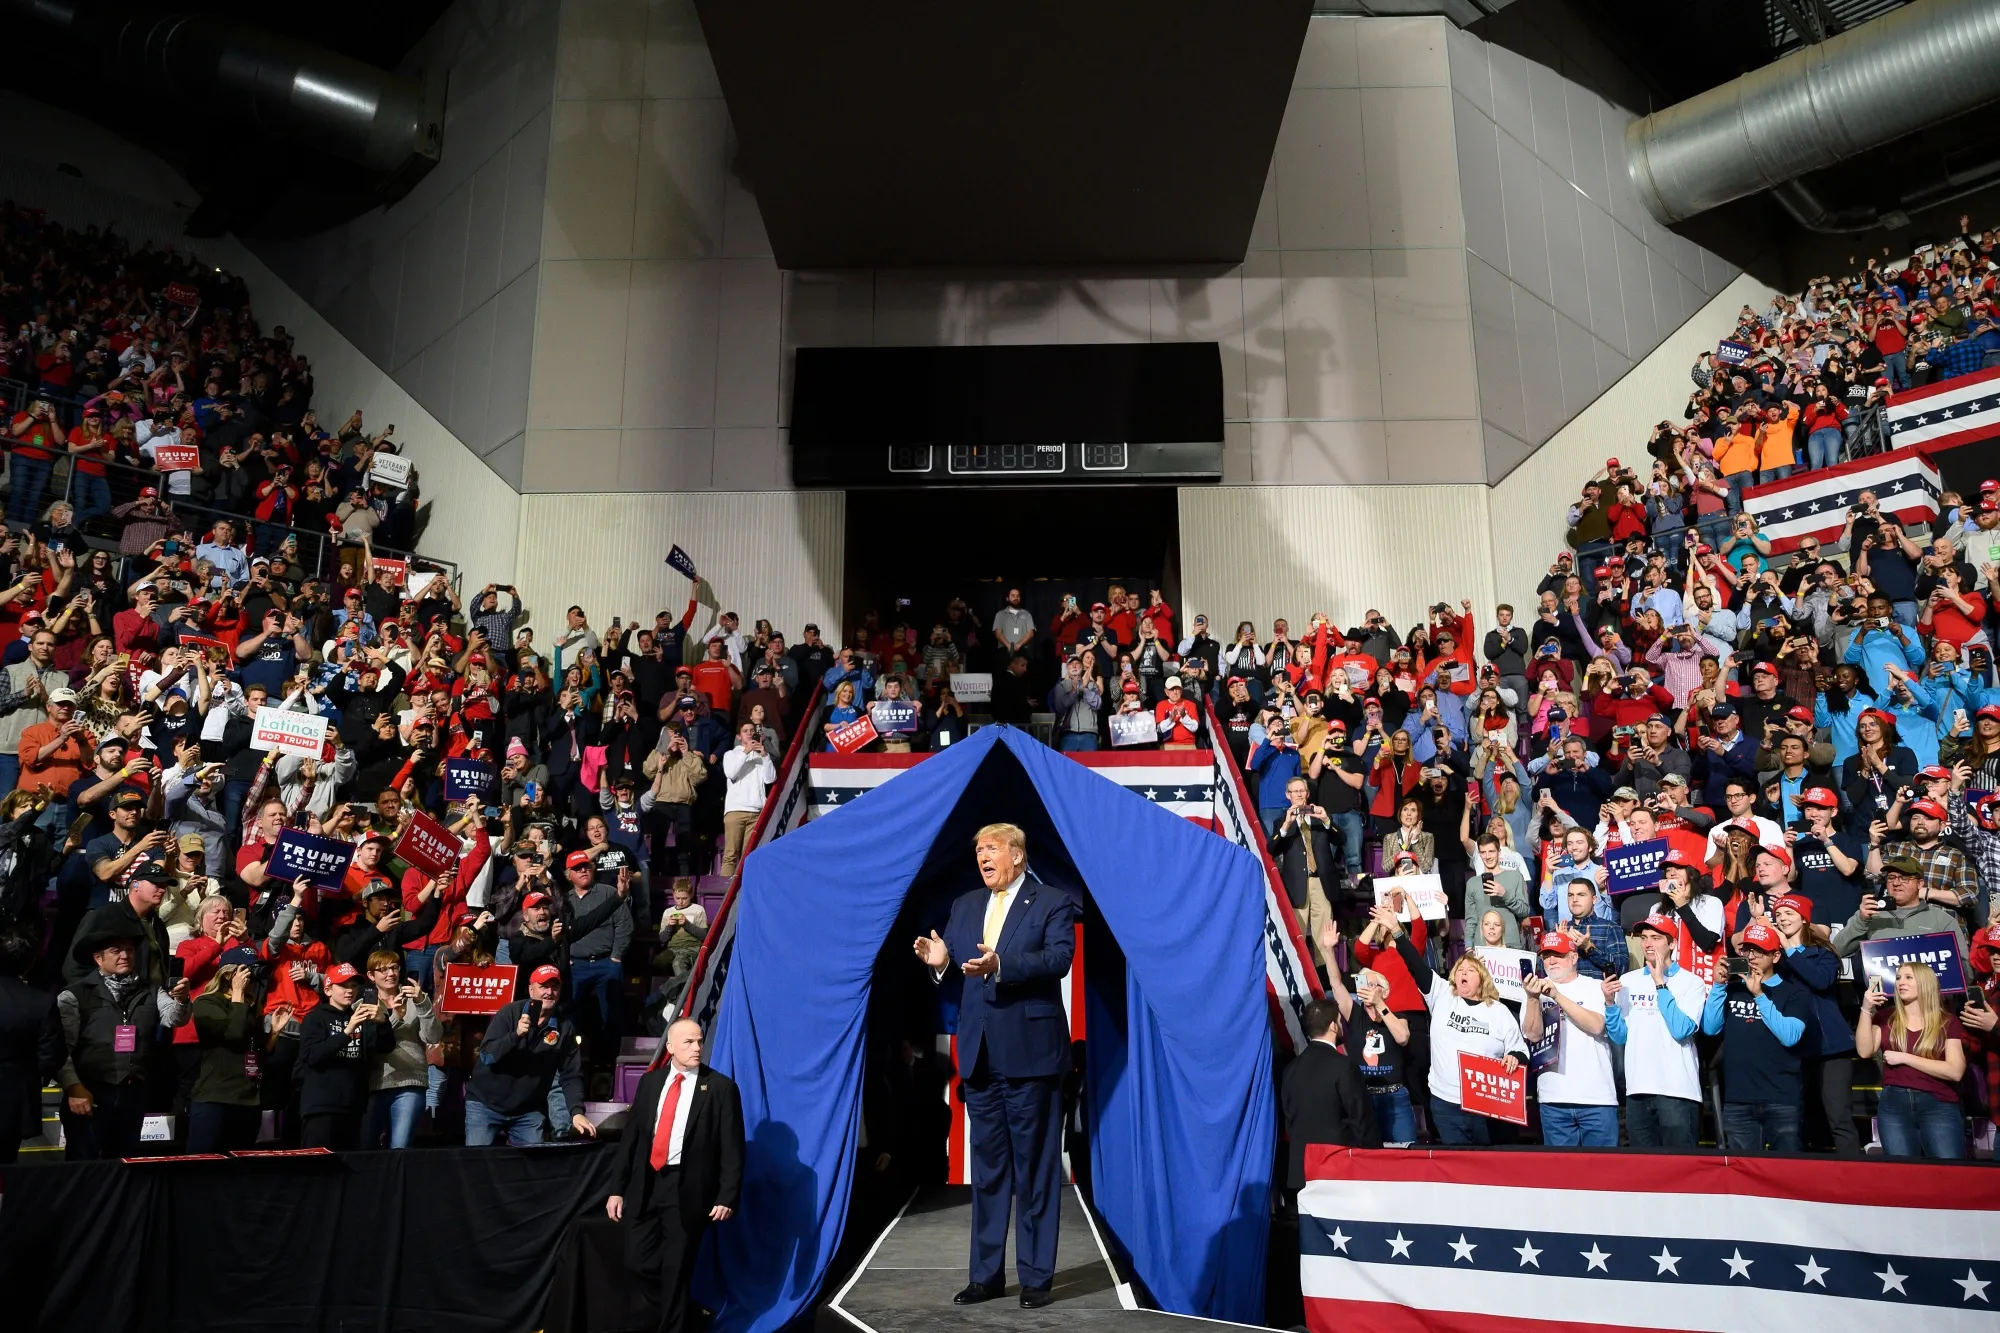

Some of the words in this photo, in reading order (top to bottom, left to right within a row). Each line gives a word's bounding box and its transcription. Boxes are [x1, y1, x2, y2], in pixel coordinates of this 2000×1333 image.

[1720, 345, 1749, 356] TRUMP
[1848, 388, 1867, 396] 2020
[1037, 445, 1062, 453] PERIOD
[378, 459, 407, 472] VETERANS
[953, 680, 991, 690] Women
[261, 715, 319, 737] Latinas
[834, 721, 868, 743] TRUMP
[260, 731, 281, 741] FOR
[283, 735, 316, 747] TRUMP
[450, 769, 493, 781] TRUMP
[455, 779, 490, 788] PENCE
[413, 824, 454, 860] TRUMP
[282, 842, 346, 865] TRUMP
[411, 836, 447, 864] PENCE
[283, 854, 336, 872] PENCE
[1609, 851, 1665, 870] TRUMP
[1801, 854, 1831, 863] TRUM
[298, 865, 316, 873] AMERICA
[1615, 862, 1660, 876] PENCE
[1871, 949, 1951, 968] TRUMP
[450, 976, 511, 989] TRUMP
[1506, 979, 1524, 988] TRUM
[454, 987, 504, 996] PENCE
[1449, 1011, 1471, 1025] COPS
[1731, 1008, 1762, 1016] PENC
[1447, 1020, 1461, 1032] FOR
[1461, 1025, 1490, 1036] TRUMP
[1464, 1068, 1520, 1090] TRUMP
[1470, 1081, 1516, 1099] PENCE
